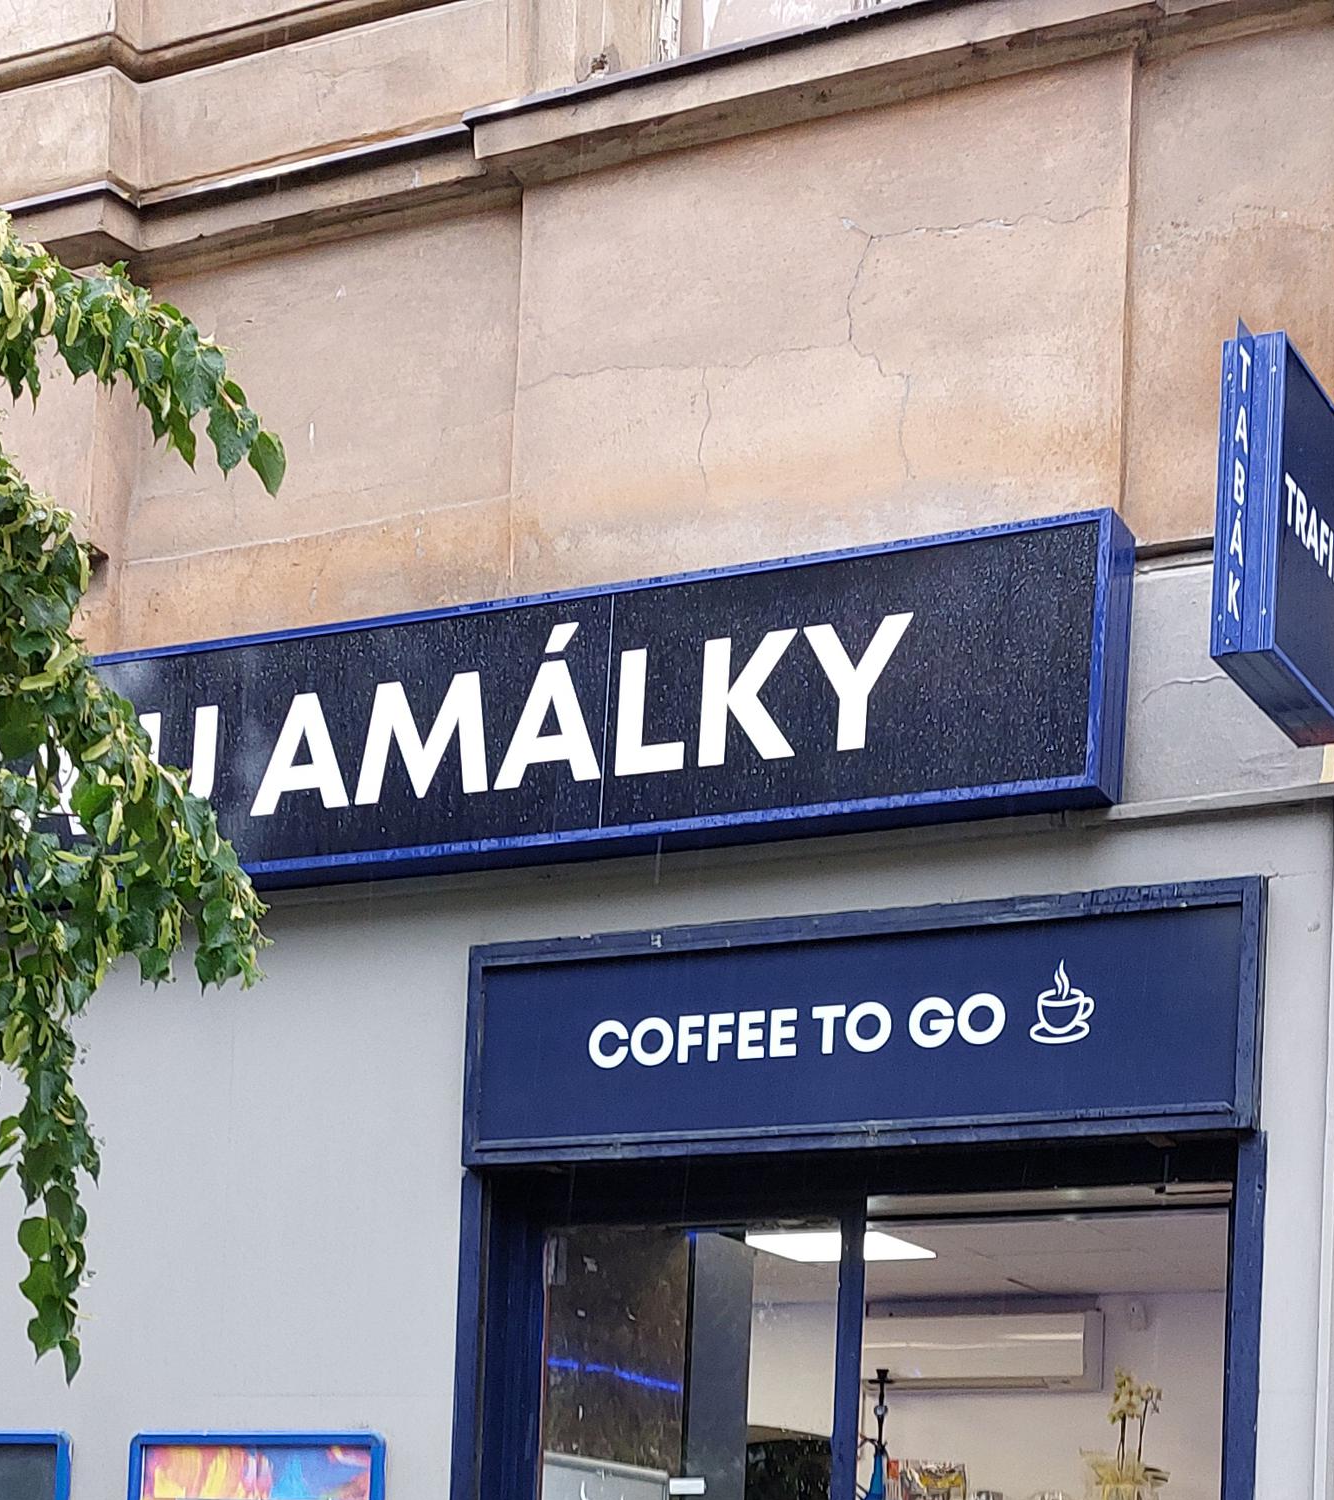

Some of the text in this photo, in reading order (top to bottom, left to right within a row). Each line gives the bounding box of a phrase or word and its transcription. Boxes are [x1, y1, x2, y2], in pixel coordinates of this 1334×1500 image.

[1226, 343, 1251, 622] TABÁK
[250, 611, 914, 817] AMÁLKY
[587, 992, 1007, 1069] COFFEE TO GO
